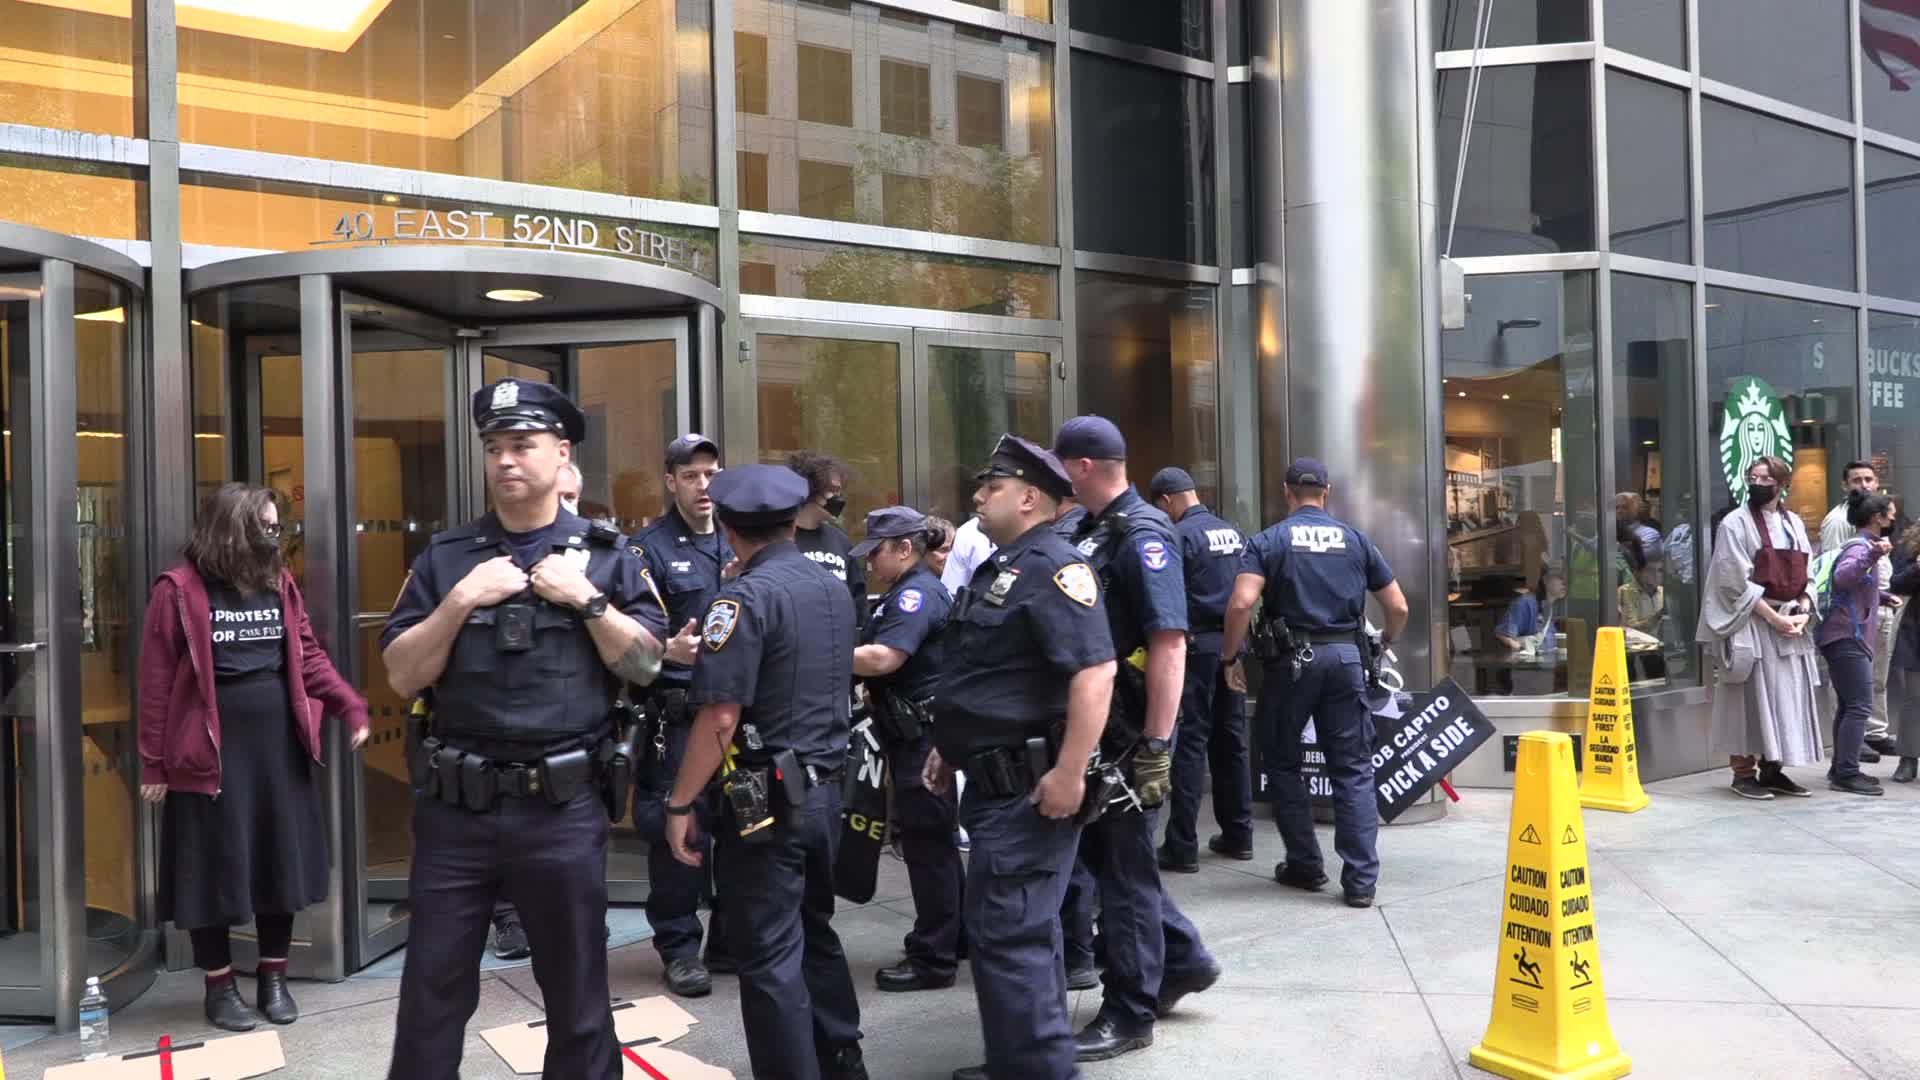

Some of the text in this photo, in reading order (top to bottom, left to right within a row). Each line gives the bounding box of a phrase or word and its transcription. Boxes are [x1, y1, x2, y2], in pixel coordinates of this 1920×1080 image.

[333, 210, 374, 240] 40
[394, 210, 494, 239] EAST
[511, 214, 599, 247] 52ND
[1205, 528, 1240, 546] NYPD
[1291, 525, 1343, 545] NYPD
[215, 608, 280, 622] PROTEST
[212, 630, 235, 643] OR
[1592, 713, 1618, 722] SAFETY
[1595, 723, 1615, 732] FIRST
[1371, 696, 1450, 773] OB CAPITO
[1600, 735, 1608, 744] LA
[1378, 760, 1425, 804] PICK
[1417, 750, 1438, 771] A
[1430, 716, 1475, 759] SIDE
[1511, 864, 1547, 889] CAUTION
[1560, 867, 1585, 889] CAUTION
[1510, 893, 1549, 918] CUIDADO
[1561, 894, 1589, 917] CUIDADO
[1506, 921, 1551, 948] ATTENTION
[1562, 924, 1593, 946] ATTENTION
